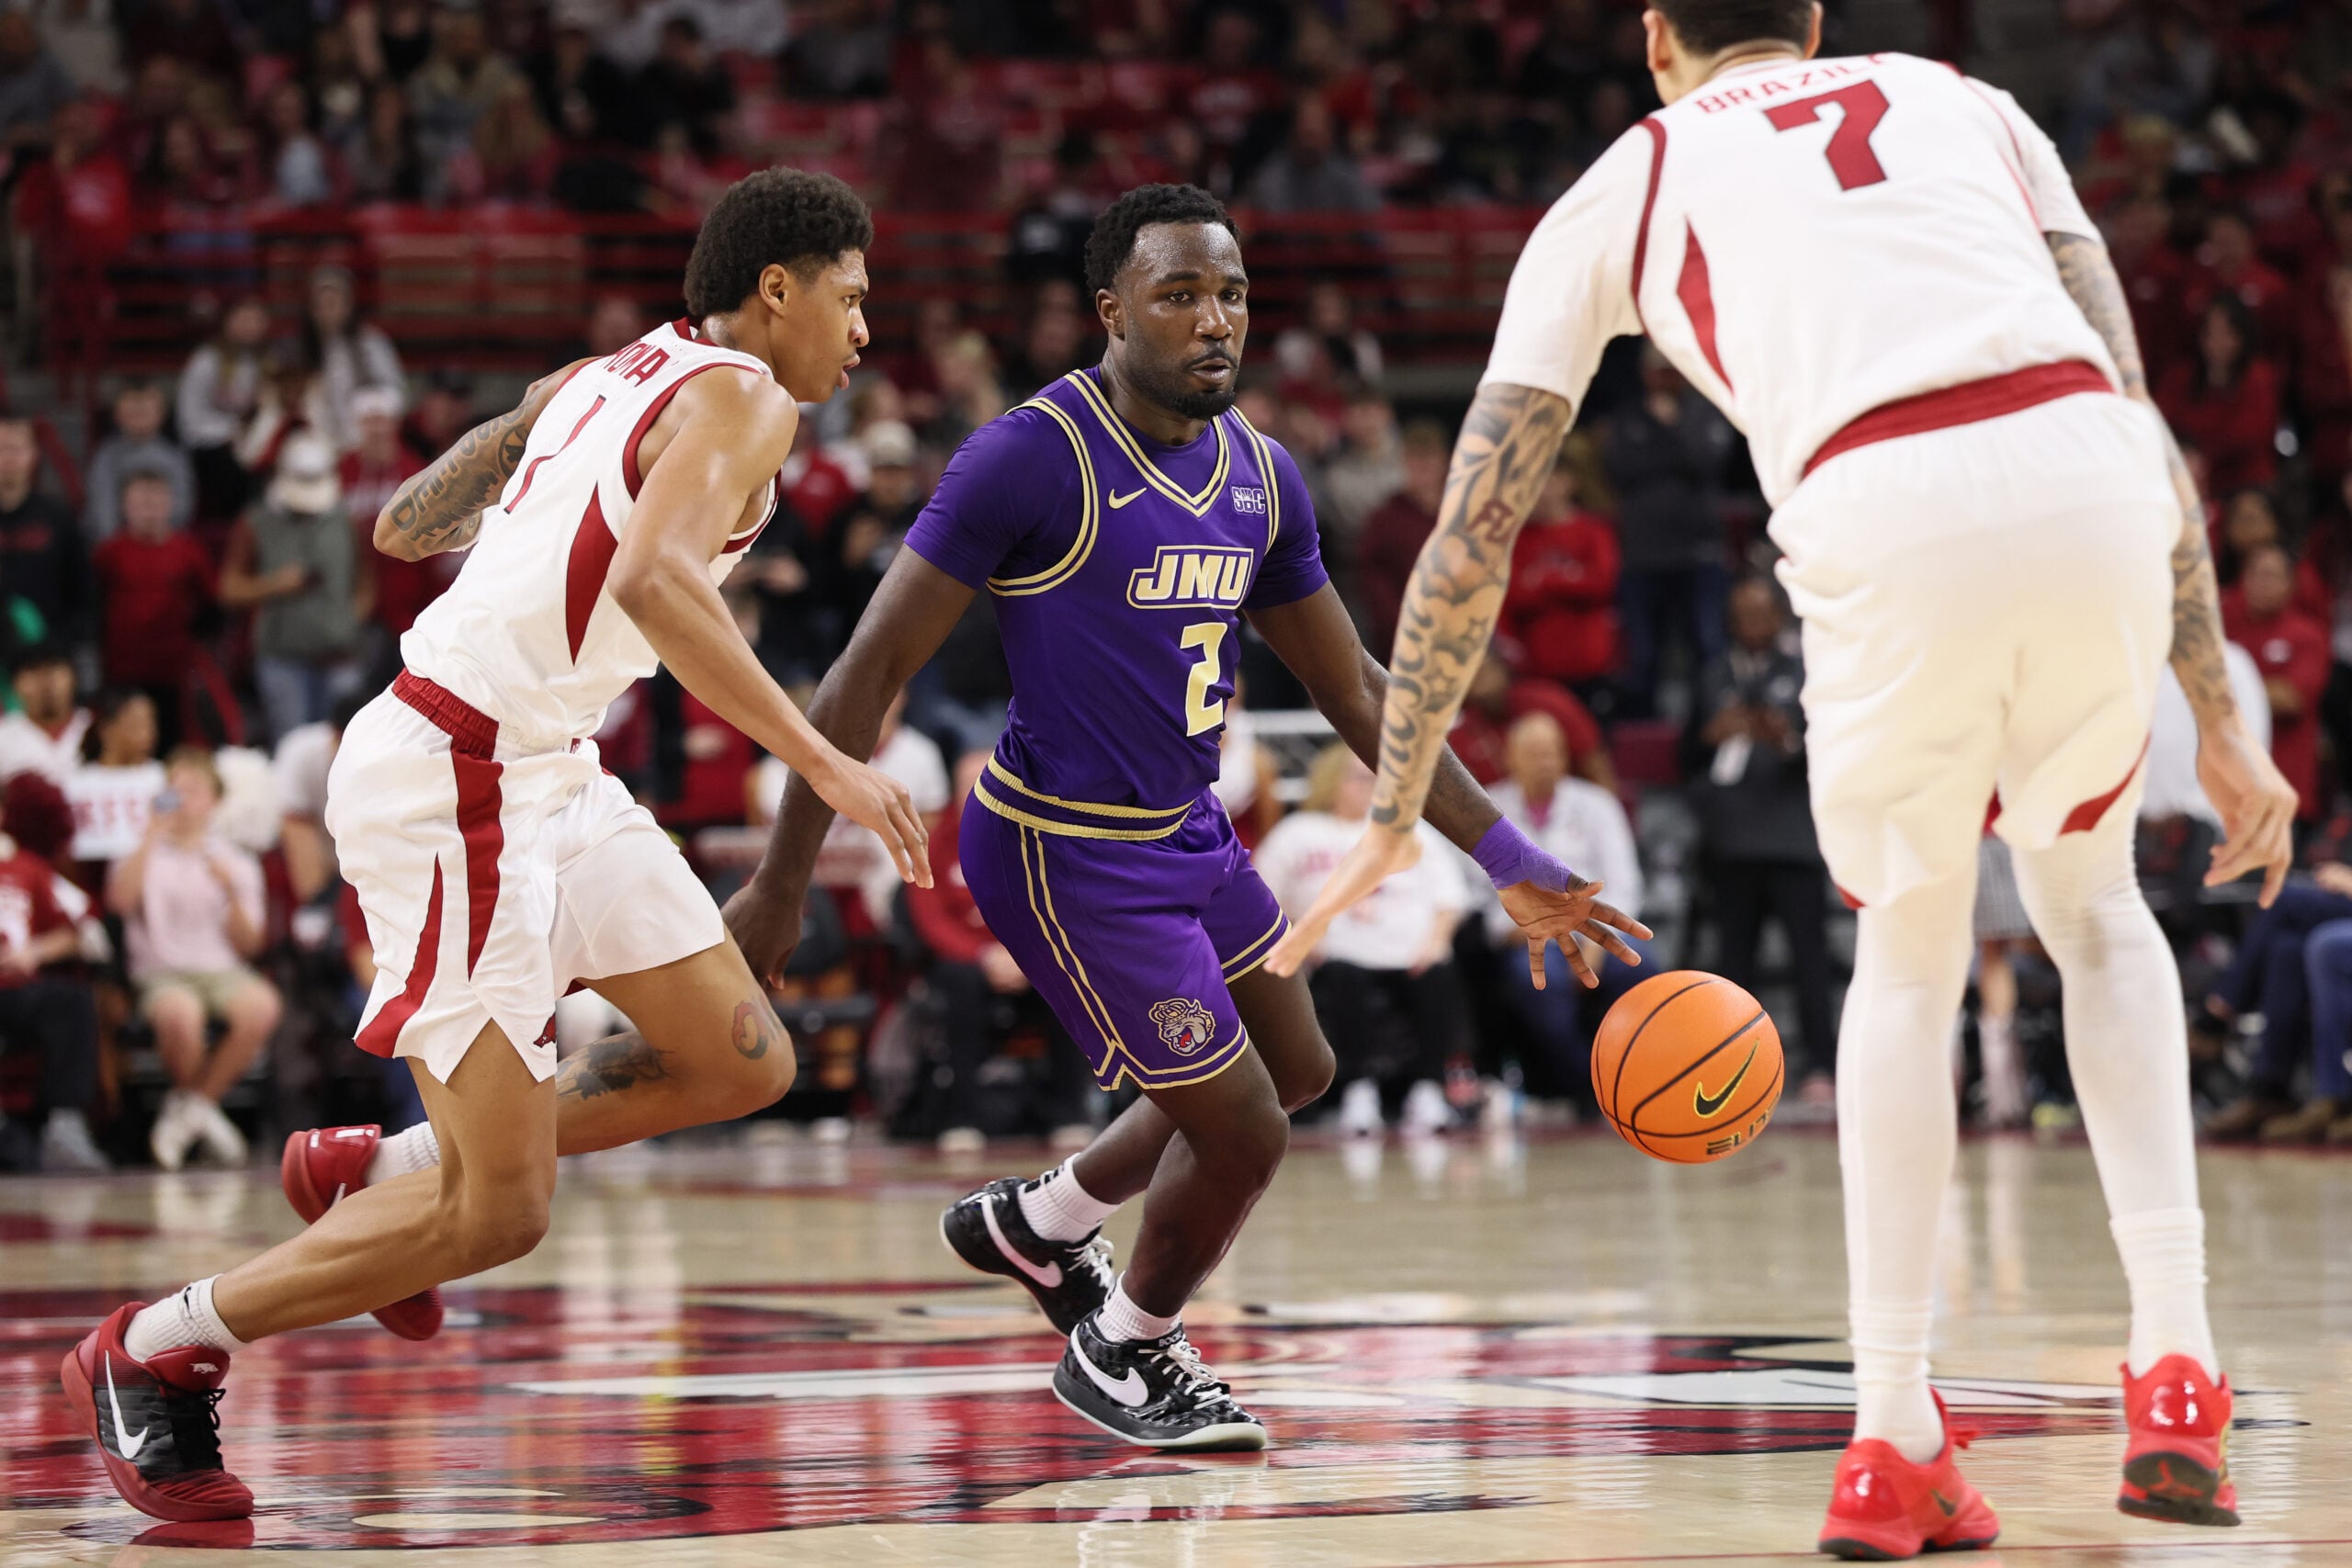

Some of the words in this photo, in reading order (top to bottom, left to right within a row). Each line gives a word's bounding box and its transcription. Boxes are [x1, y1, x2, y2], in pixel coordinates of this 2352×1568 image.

[1763, 79, 1890, 191] 7
[503, 394, 606, 514] 1
[1231, 486, 1266, 514] SBC
[1135, 553, 1252, 601] JMU
[1180, 622, 1228, 738] 2
